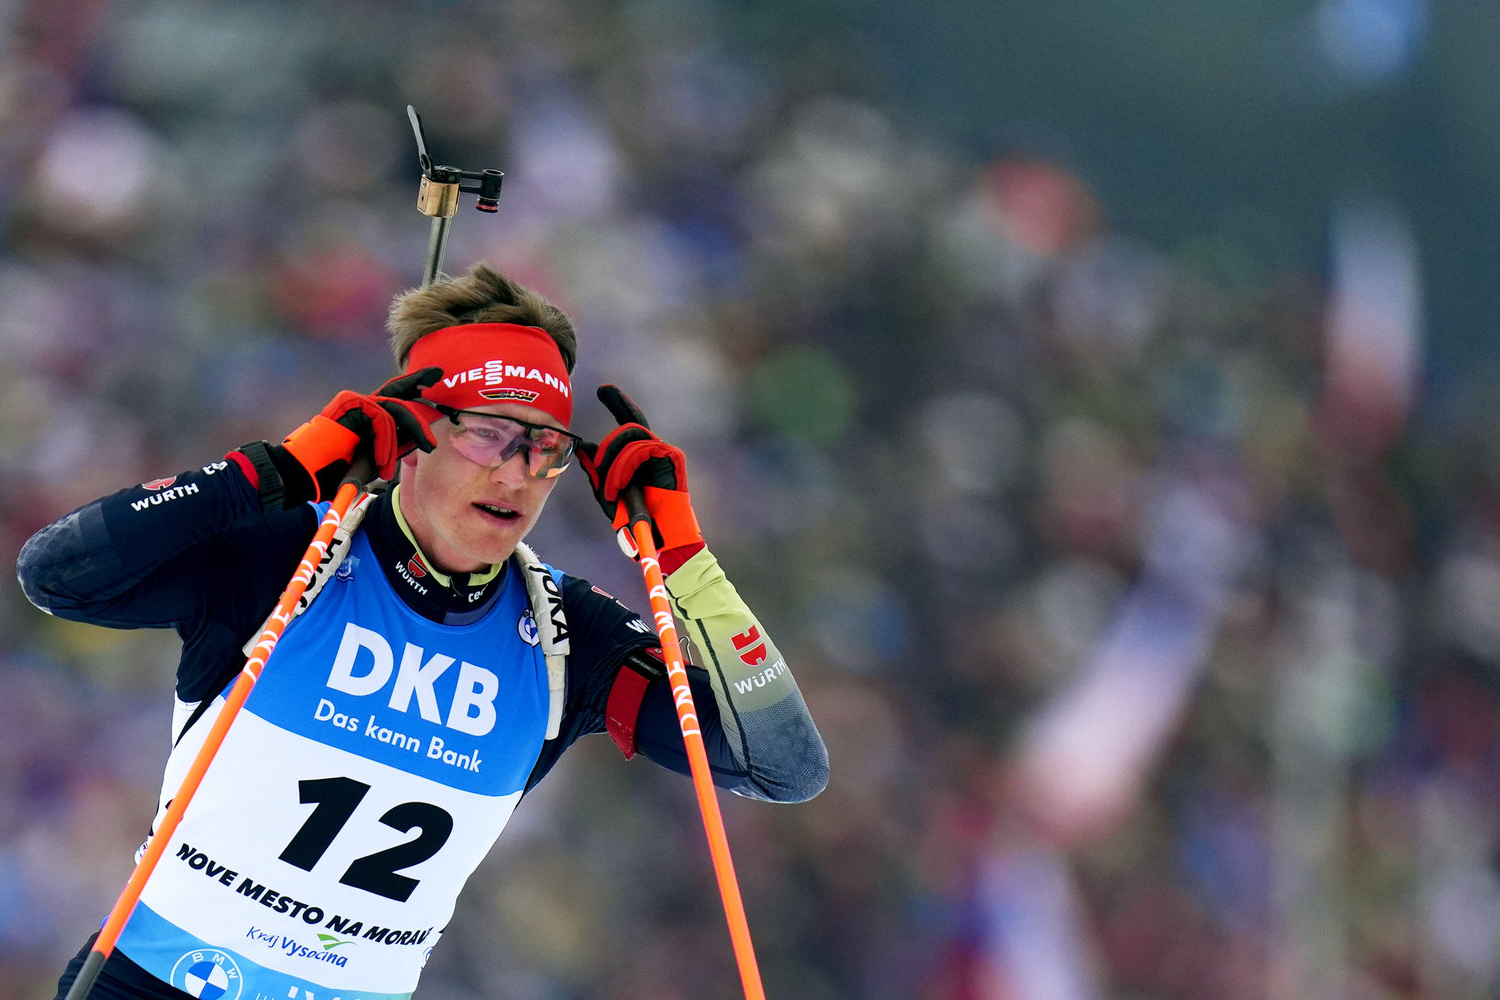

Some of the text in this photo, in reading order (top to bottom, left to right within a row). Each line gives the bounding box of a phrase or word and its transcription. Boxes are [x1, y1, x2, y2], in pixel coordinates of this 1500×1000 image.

[442, 360, 569, 398] VIESSMANN
[243, 509, 341, 683] ONE WAY
[641, 557, 675, 639] WAY
[326, 622, 500, 737] DKB
[733, 657, 787, 695] WÜRTH
[314, 698, 483, 773] Das kann Bank
[278, 776, 454, 903] 12
[175, 843, 435, 946] NOVE MESTO NA MORAV
[192, 952, 239, 979] BMW
[246, 926, 349, 968] Kraj Vysocina
